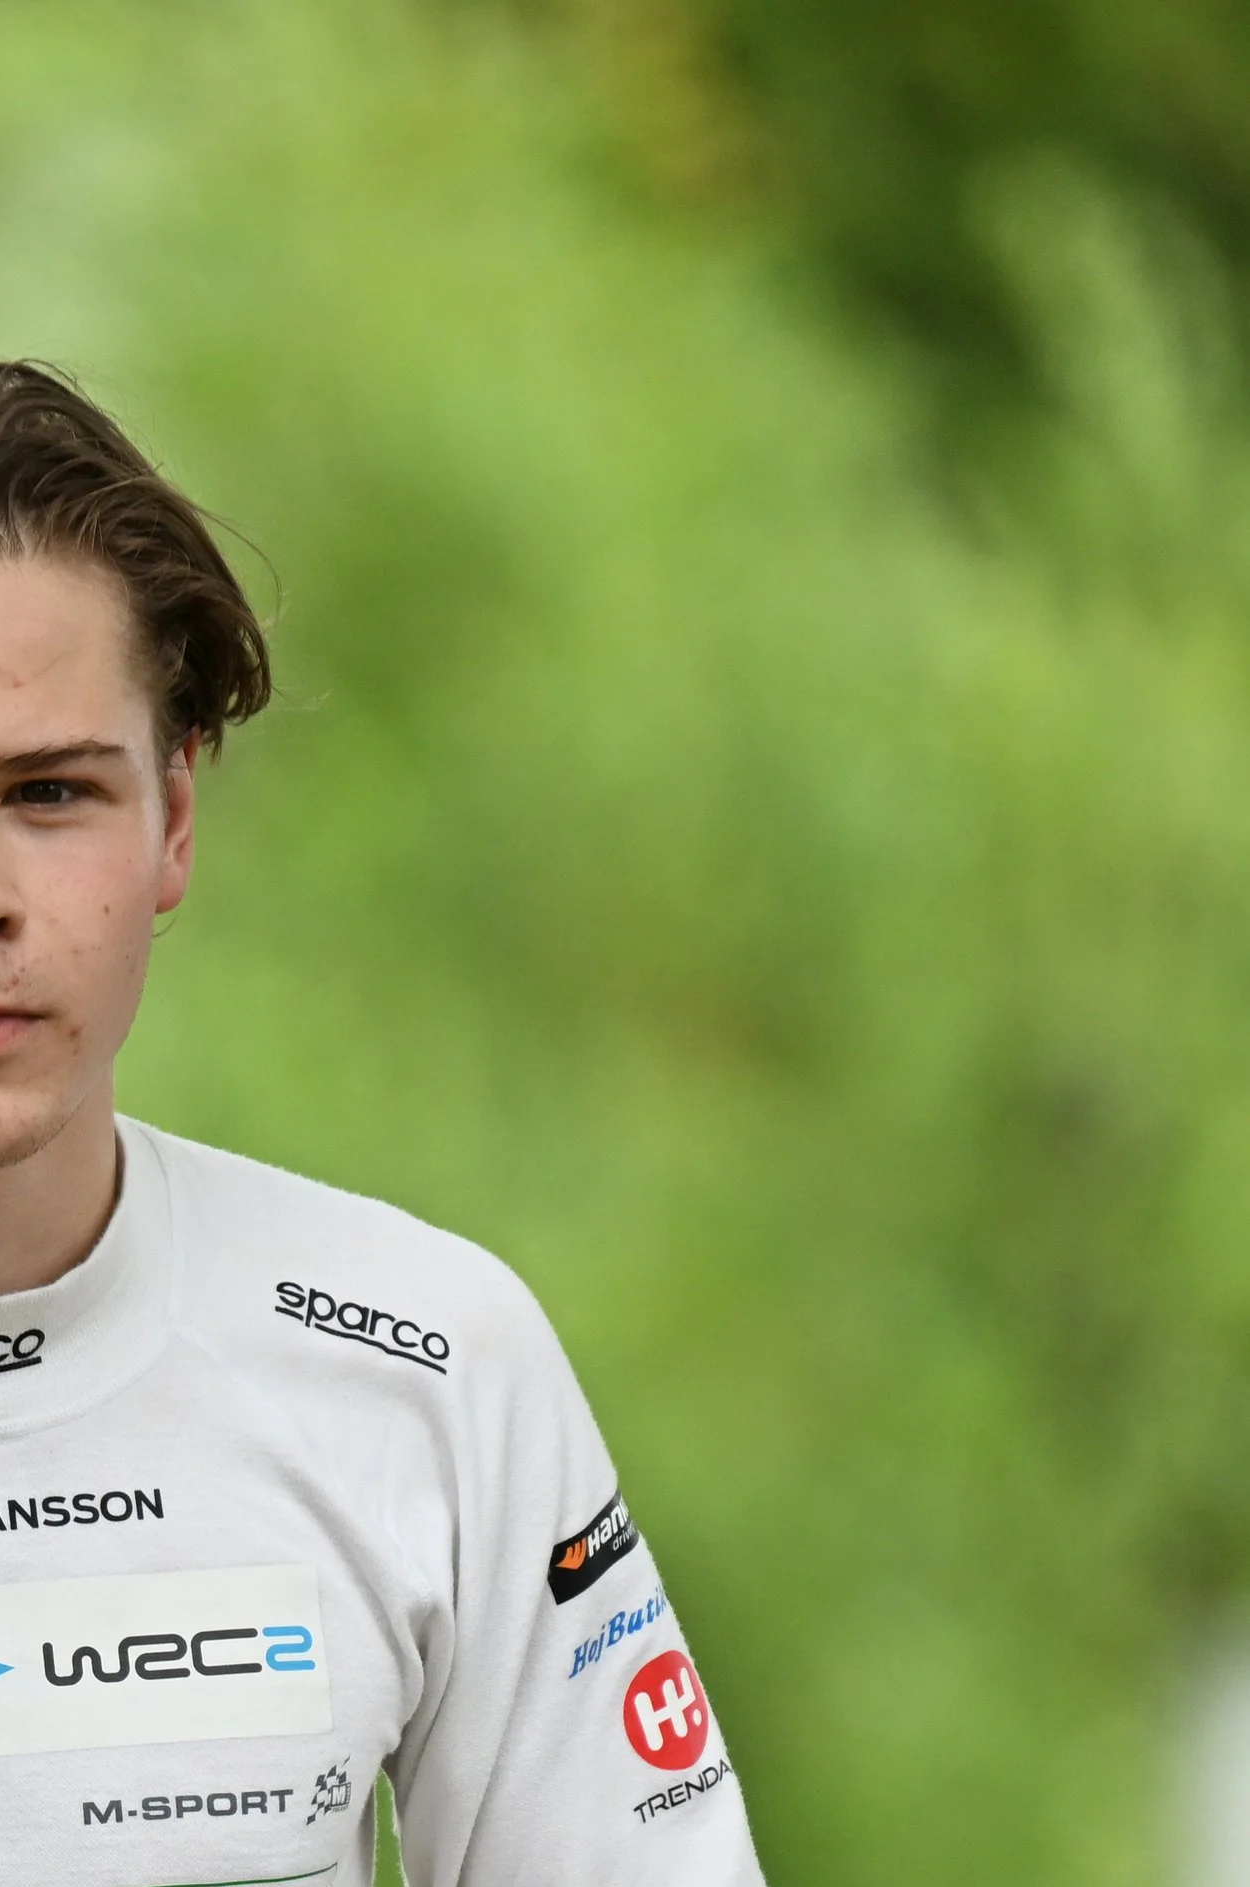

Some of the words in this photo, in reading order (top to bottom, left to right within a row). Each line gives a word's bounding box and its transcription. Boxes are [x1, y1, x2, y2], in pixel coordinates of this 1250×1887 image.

[276, 1280, 450, 1366] sparco
[42, 1625, 316, 1687] WRC2
[82, 1789, 294, 1825] M-SPORT
